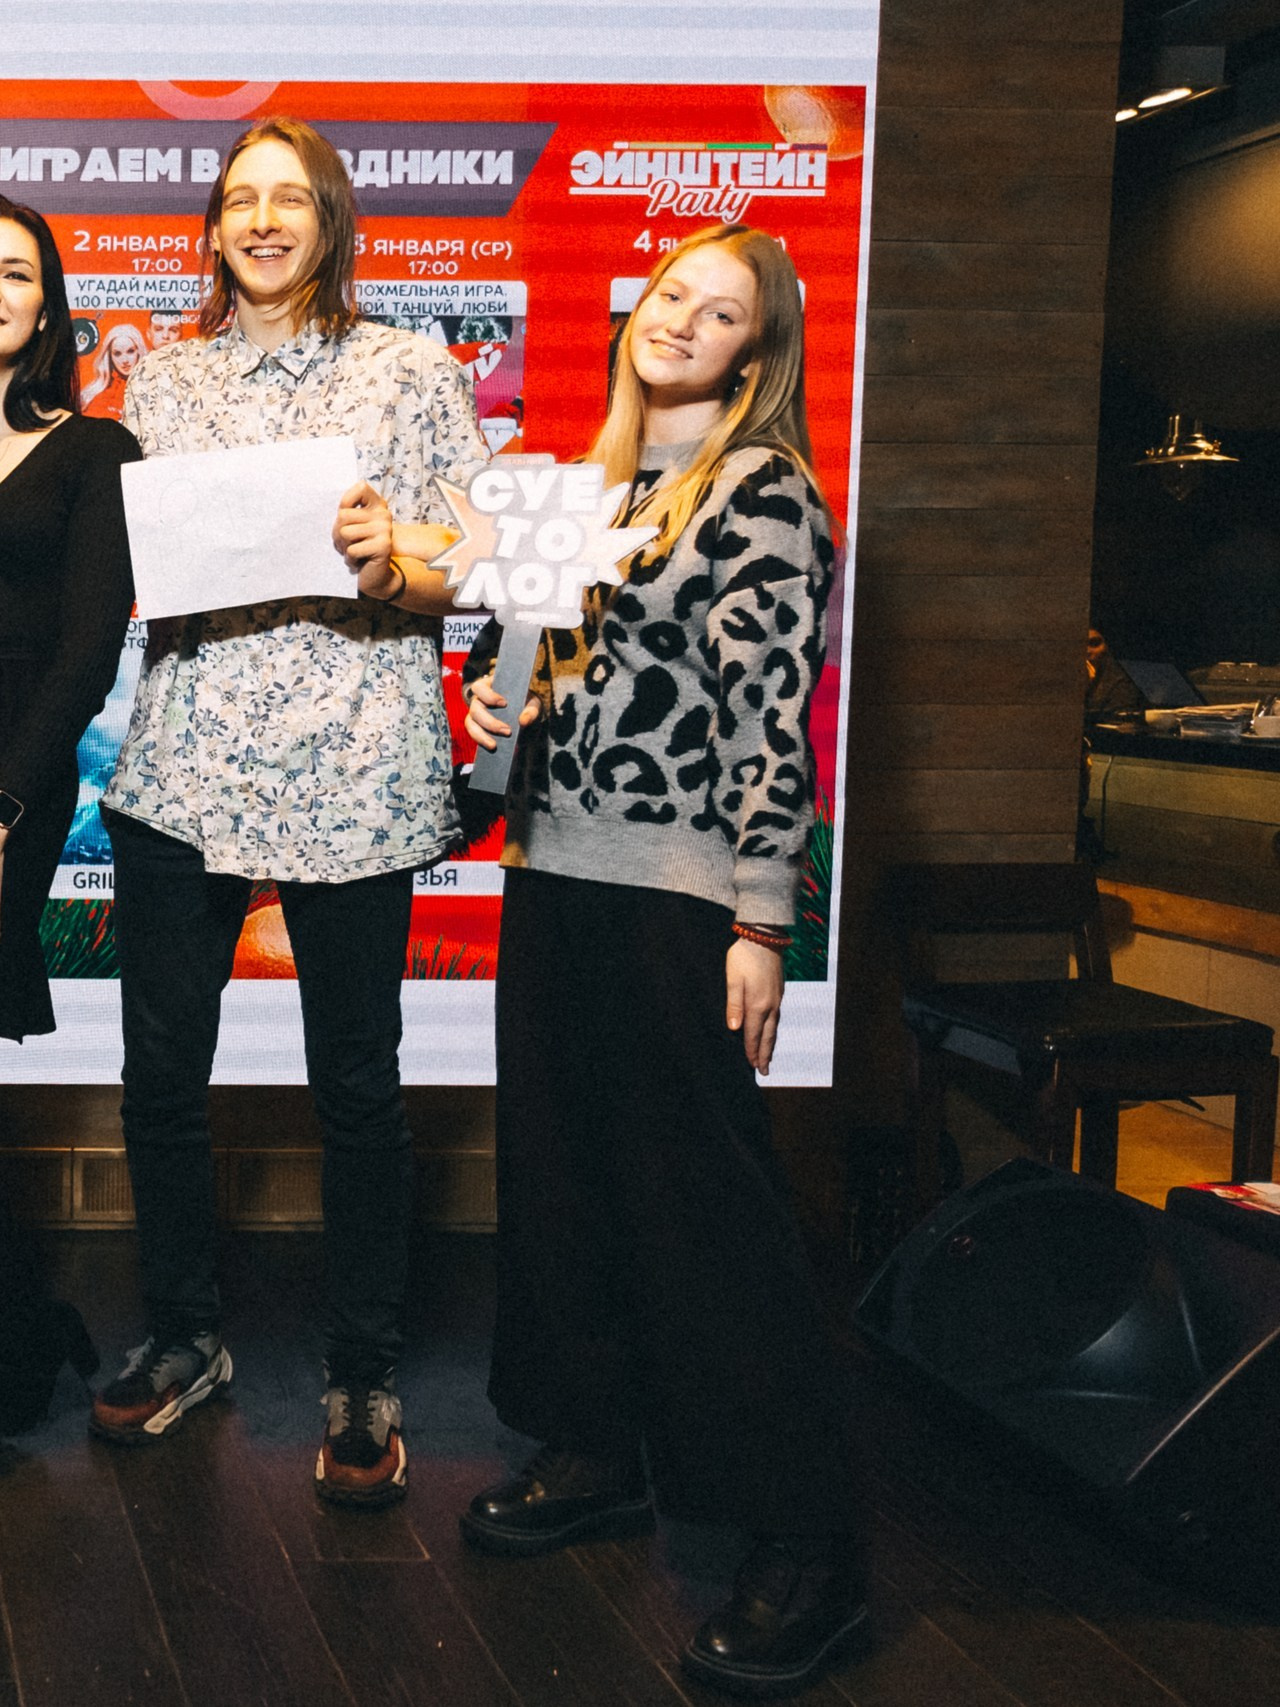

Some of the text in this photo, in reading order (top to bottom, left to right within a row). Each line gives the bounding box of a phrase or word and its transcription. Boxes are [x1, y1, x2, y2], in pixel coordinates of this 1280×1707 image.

[0, 147, 182, 182] ИГРАЕМ
[191, 148, 220, 183] В
[646, 178, 752, 224] Party
[73, 230, 91, 251] 2
[97, 236, 189, 252] ЯНВАРЯ
[373, 240, 464, 256] ЯНВАРЯ
[471, 241, 512, 260] (СР)
[634, 230, 652, 252] 4
[132, 258, 182, 273] 17:00
[408, 261, 458, 275] 17:00
[77, 278, 140, 294] УГАДАЙ
[75, 296, 101, 309] 100
[106, 296, 175, 309] РУССКИХ
[461, 301, 508, 314] ЛЮБИ
